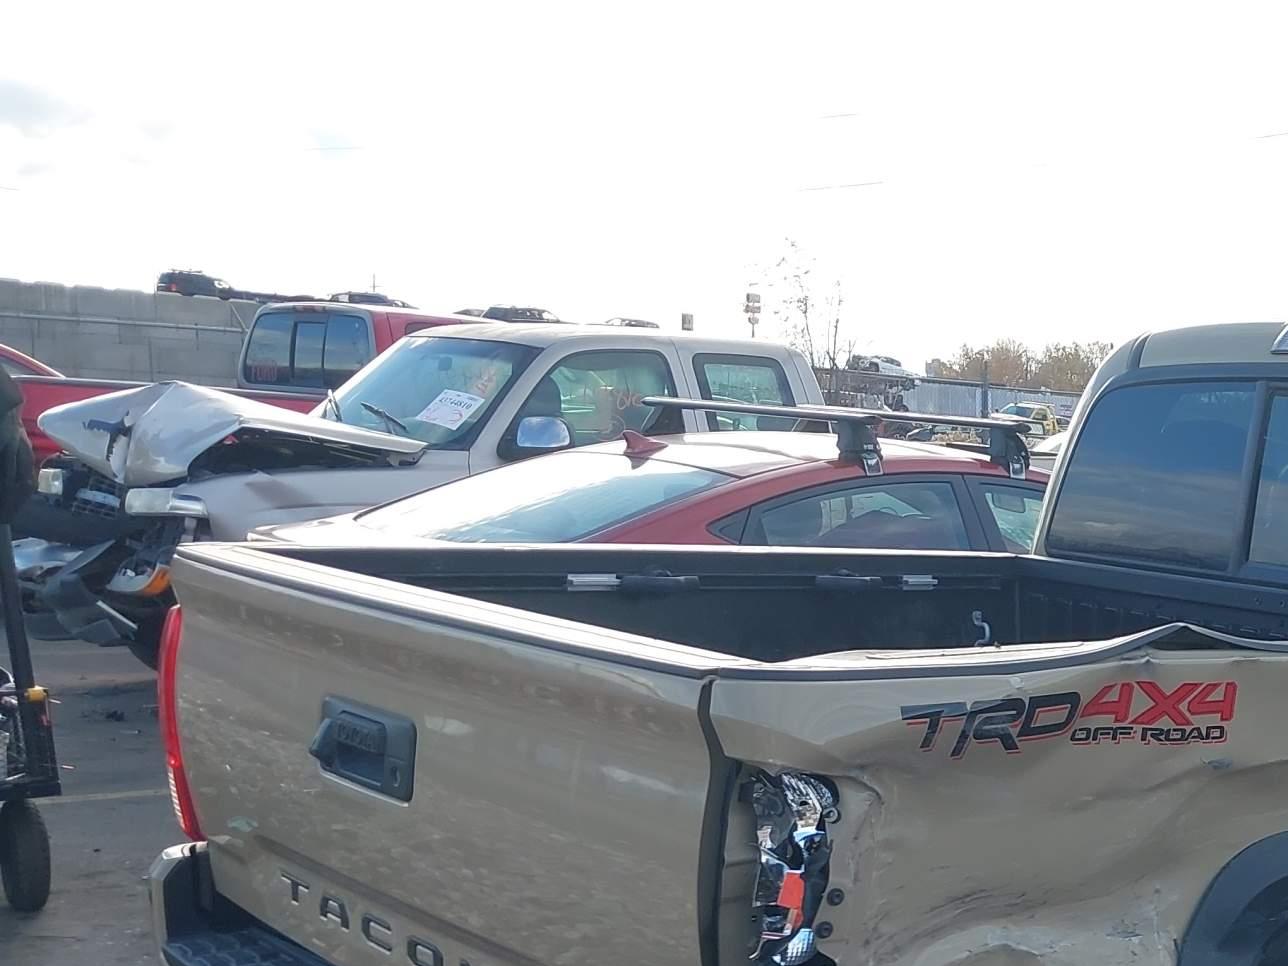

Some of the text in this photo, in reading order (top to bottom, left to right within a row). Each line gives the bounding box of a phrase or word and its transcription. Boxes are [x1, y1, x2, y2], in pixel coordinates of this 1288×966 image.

[901, 692, 1082, 760] TRD
[1070, 725, 1227, 745] OFF ROAD
